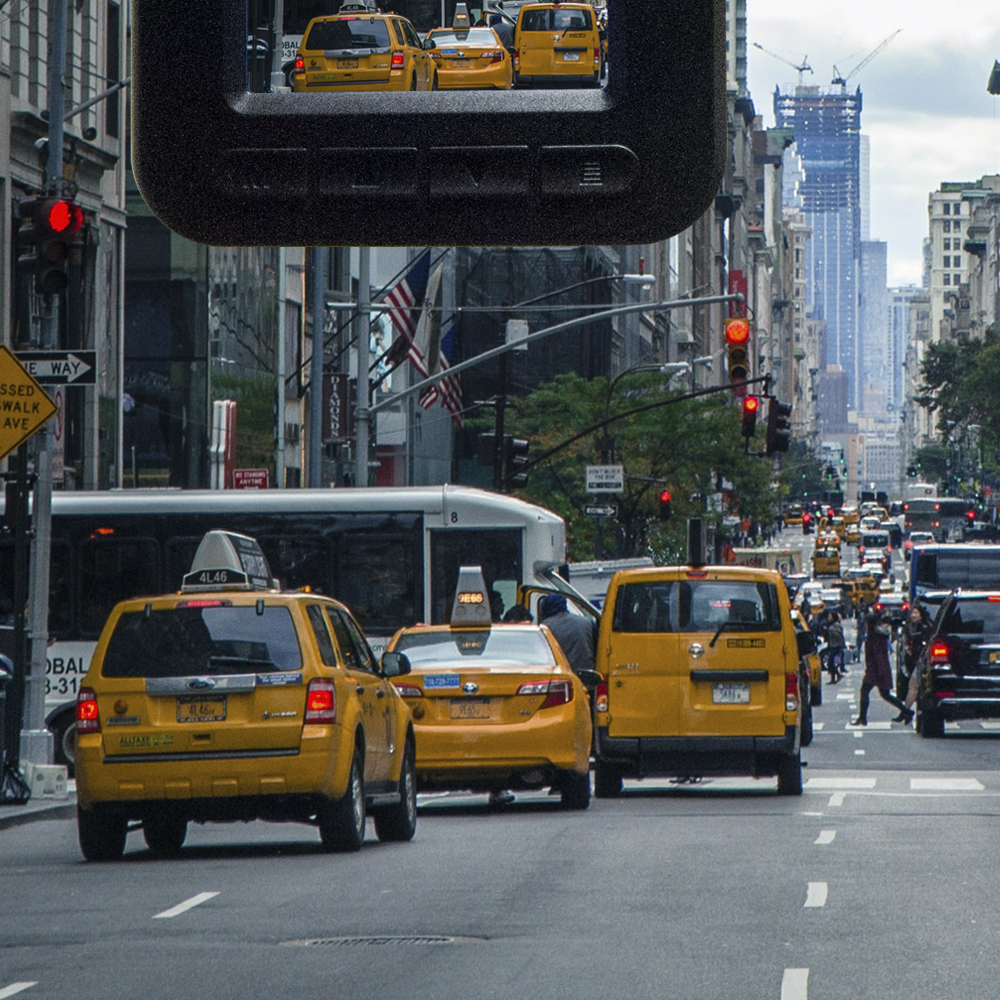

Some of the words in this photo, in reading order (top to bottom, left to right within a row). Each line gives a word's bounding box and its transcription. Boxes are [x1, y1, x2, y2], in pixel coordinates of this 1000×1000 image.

[50, 362, 81, 375] WAY
[329, 376, 341, 437] DIAMONDS
[3, 417, 29, 430] AVE
[451, 511, 458, 523] 8
[199, 571, 228, 583] 4L46
